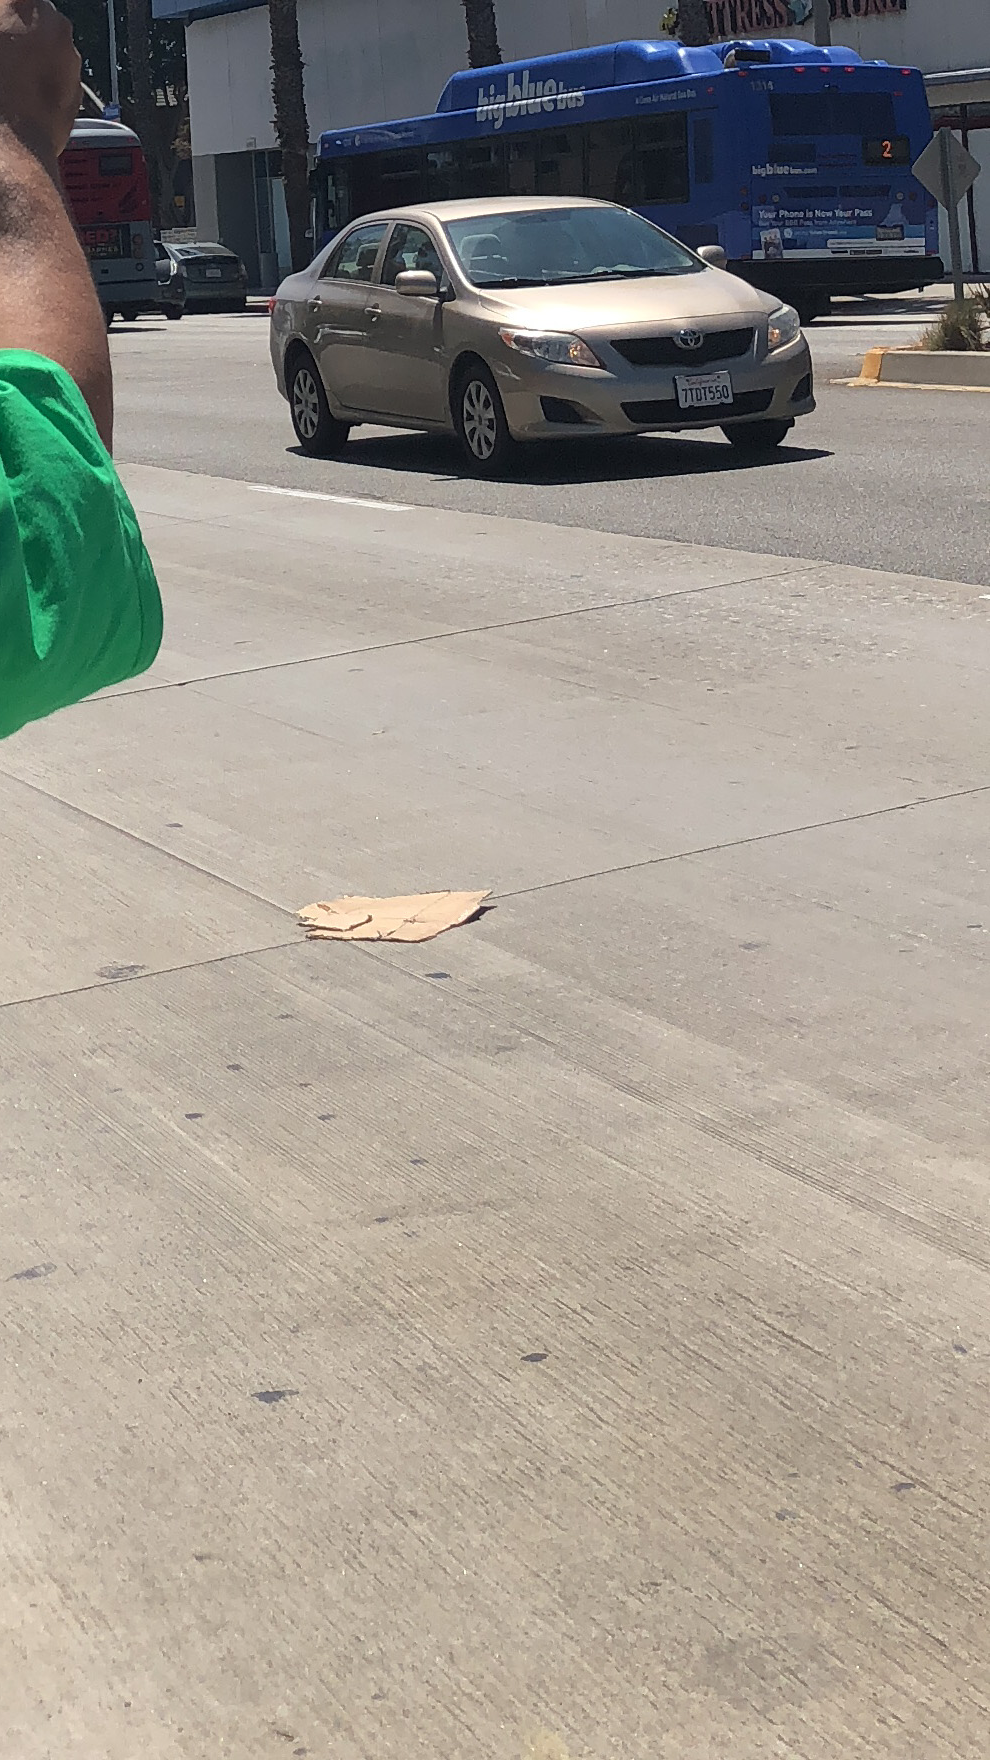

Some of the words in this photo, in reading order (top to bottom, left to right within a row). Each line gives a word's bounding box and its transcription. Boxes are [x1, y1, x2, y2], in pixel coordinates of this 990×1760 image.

[881, 140, 893, 158] 2
[759, 210, 777, 219] Your
[778, 209, 805, 218] Phone
[834, 208, 853, 218] Your
[854, 208, 873, 217] Pass
[681, 385, 729, 403] 7TDT550
